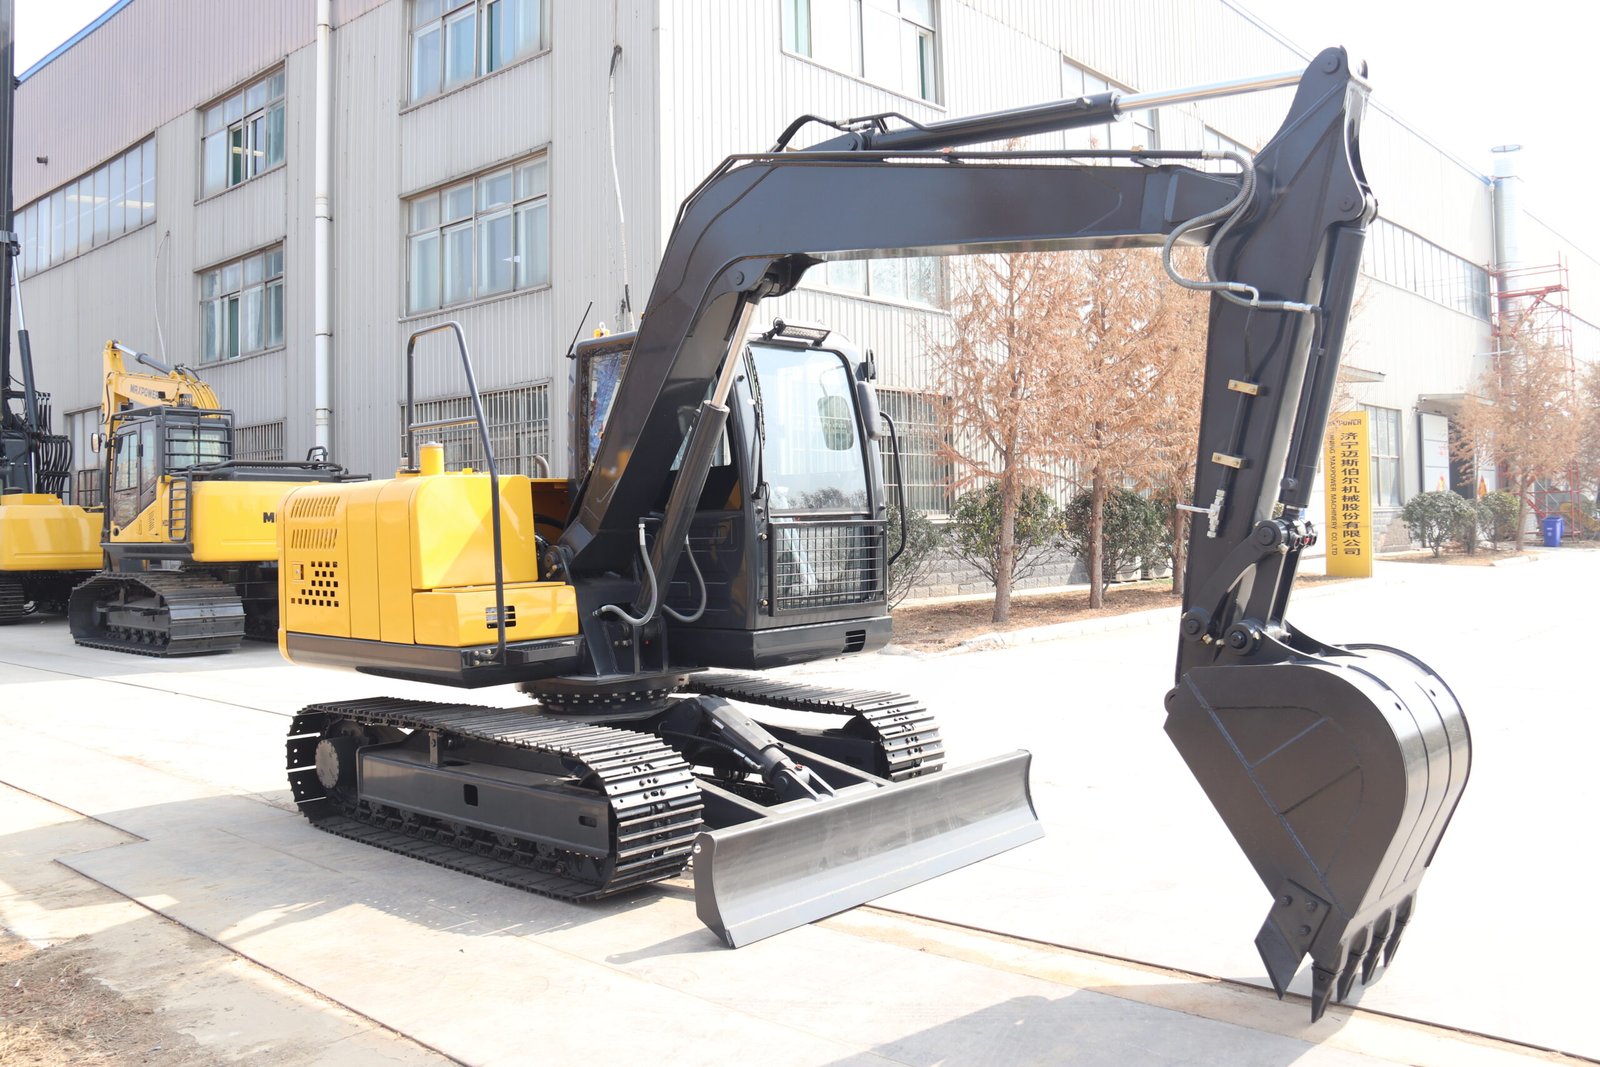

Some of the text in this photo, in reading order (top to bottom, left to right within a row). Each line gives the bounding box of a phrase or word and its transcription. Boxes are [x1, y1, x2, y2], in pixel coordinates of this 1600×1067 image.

[1340, 432, 1360, 556] 济宁迈斯伯尔机械股份有限公司
